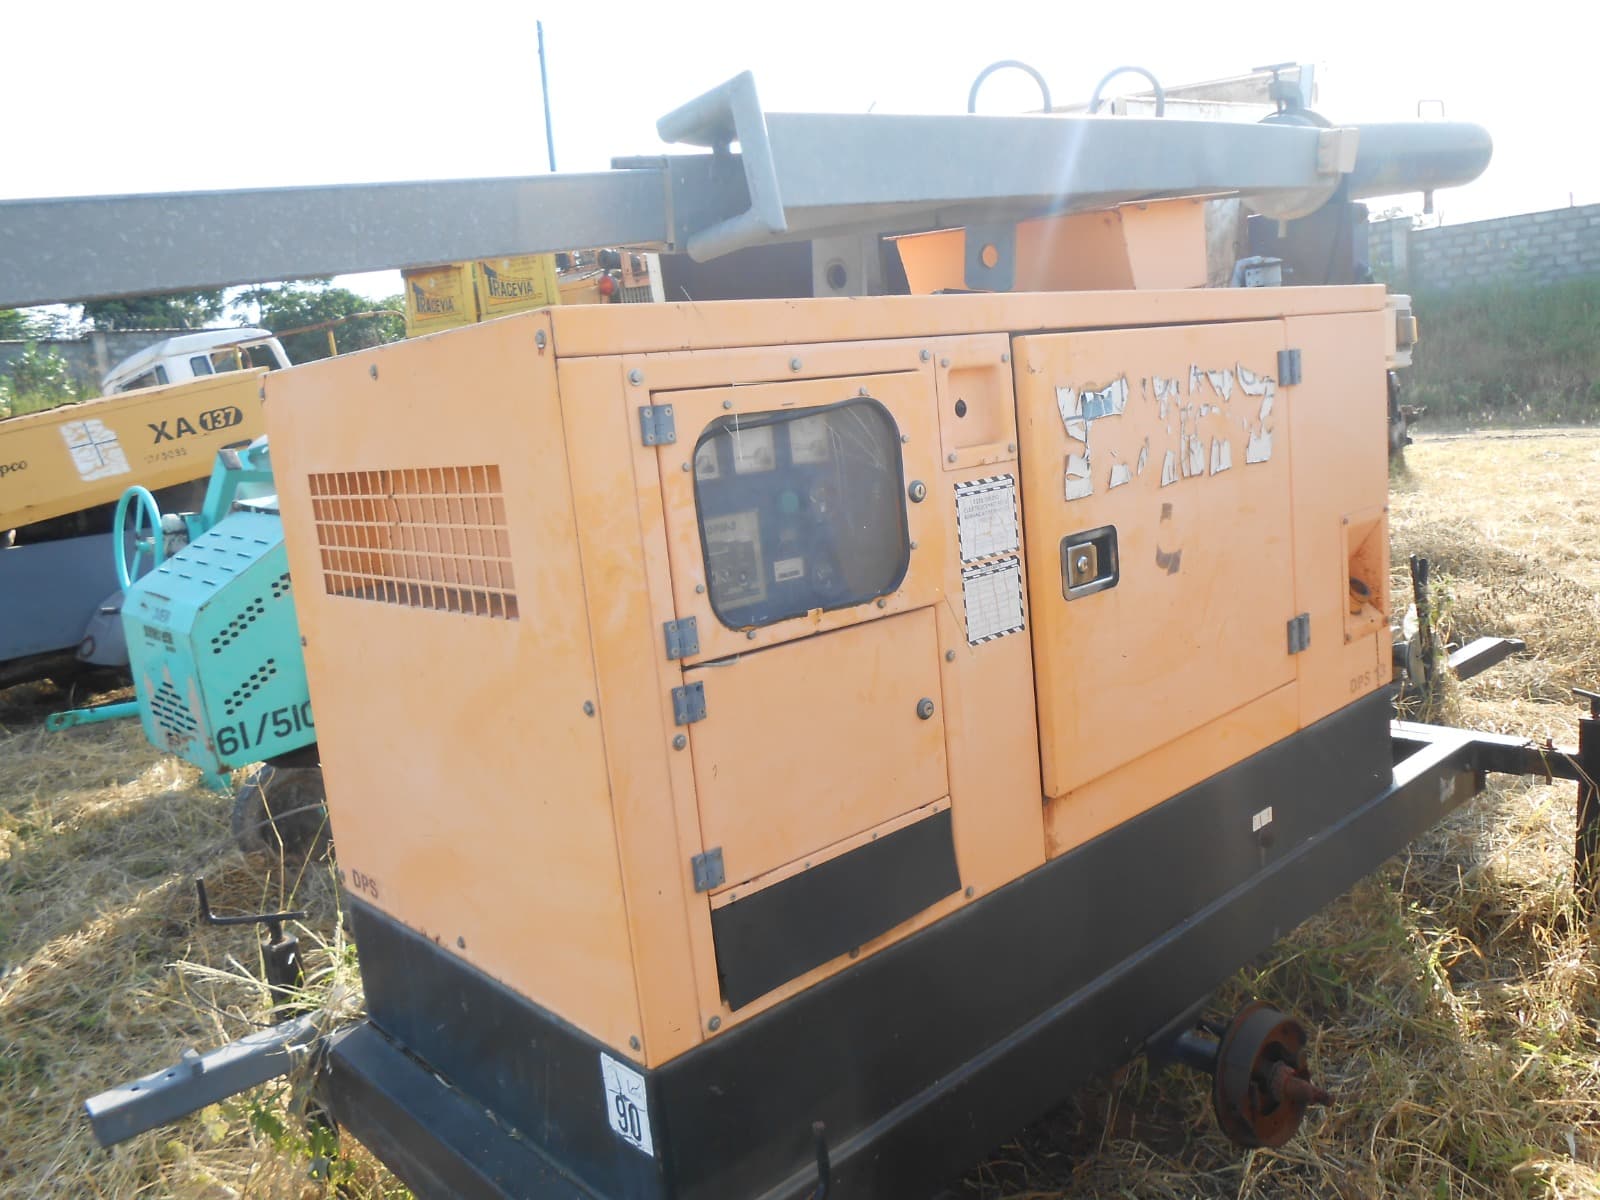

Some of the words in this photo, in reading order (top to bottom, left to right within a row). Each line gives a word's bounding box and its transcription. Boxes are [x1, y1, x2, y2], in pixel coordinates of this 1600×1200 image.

[147, 417, 197, 444] XA
[202, 408, 237, 430] 137
[352, 869, 379, 899] DPS
[616, 1095, 642, 1142] 90
